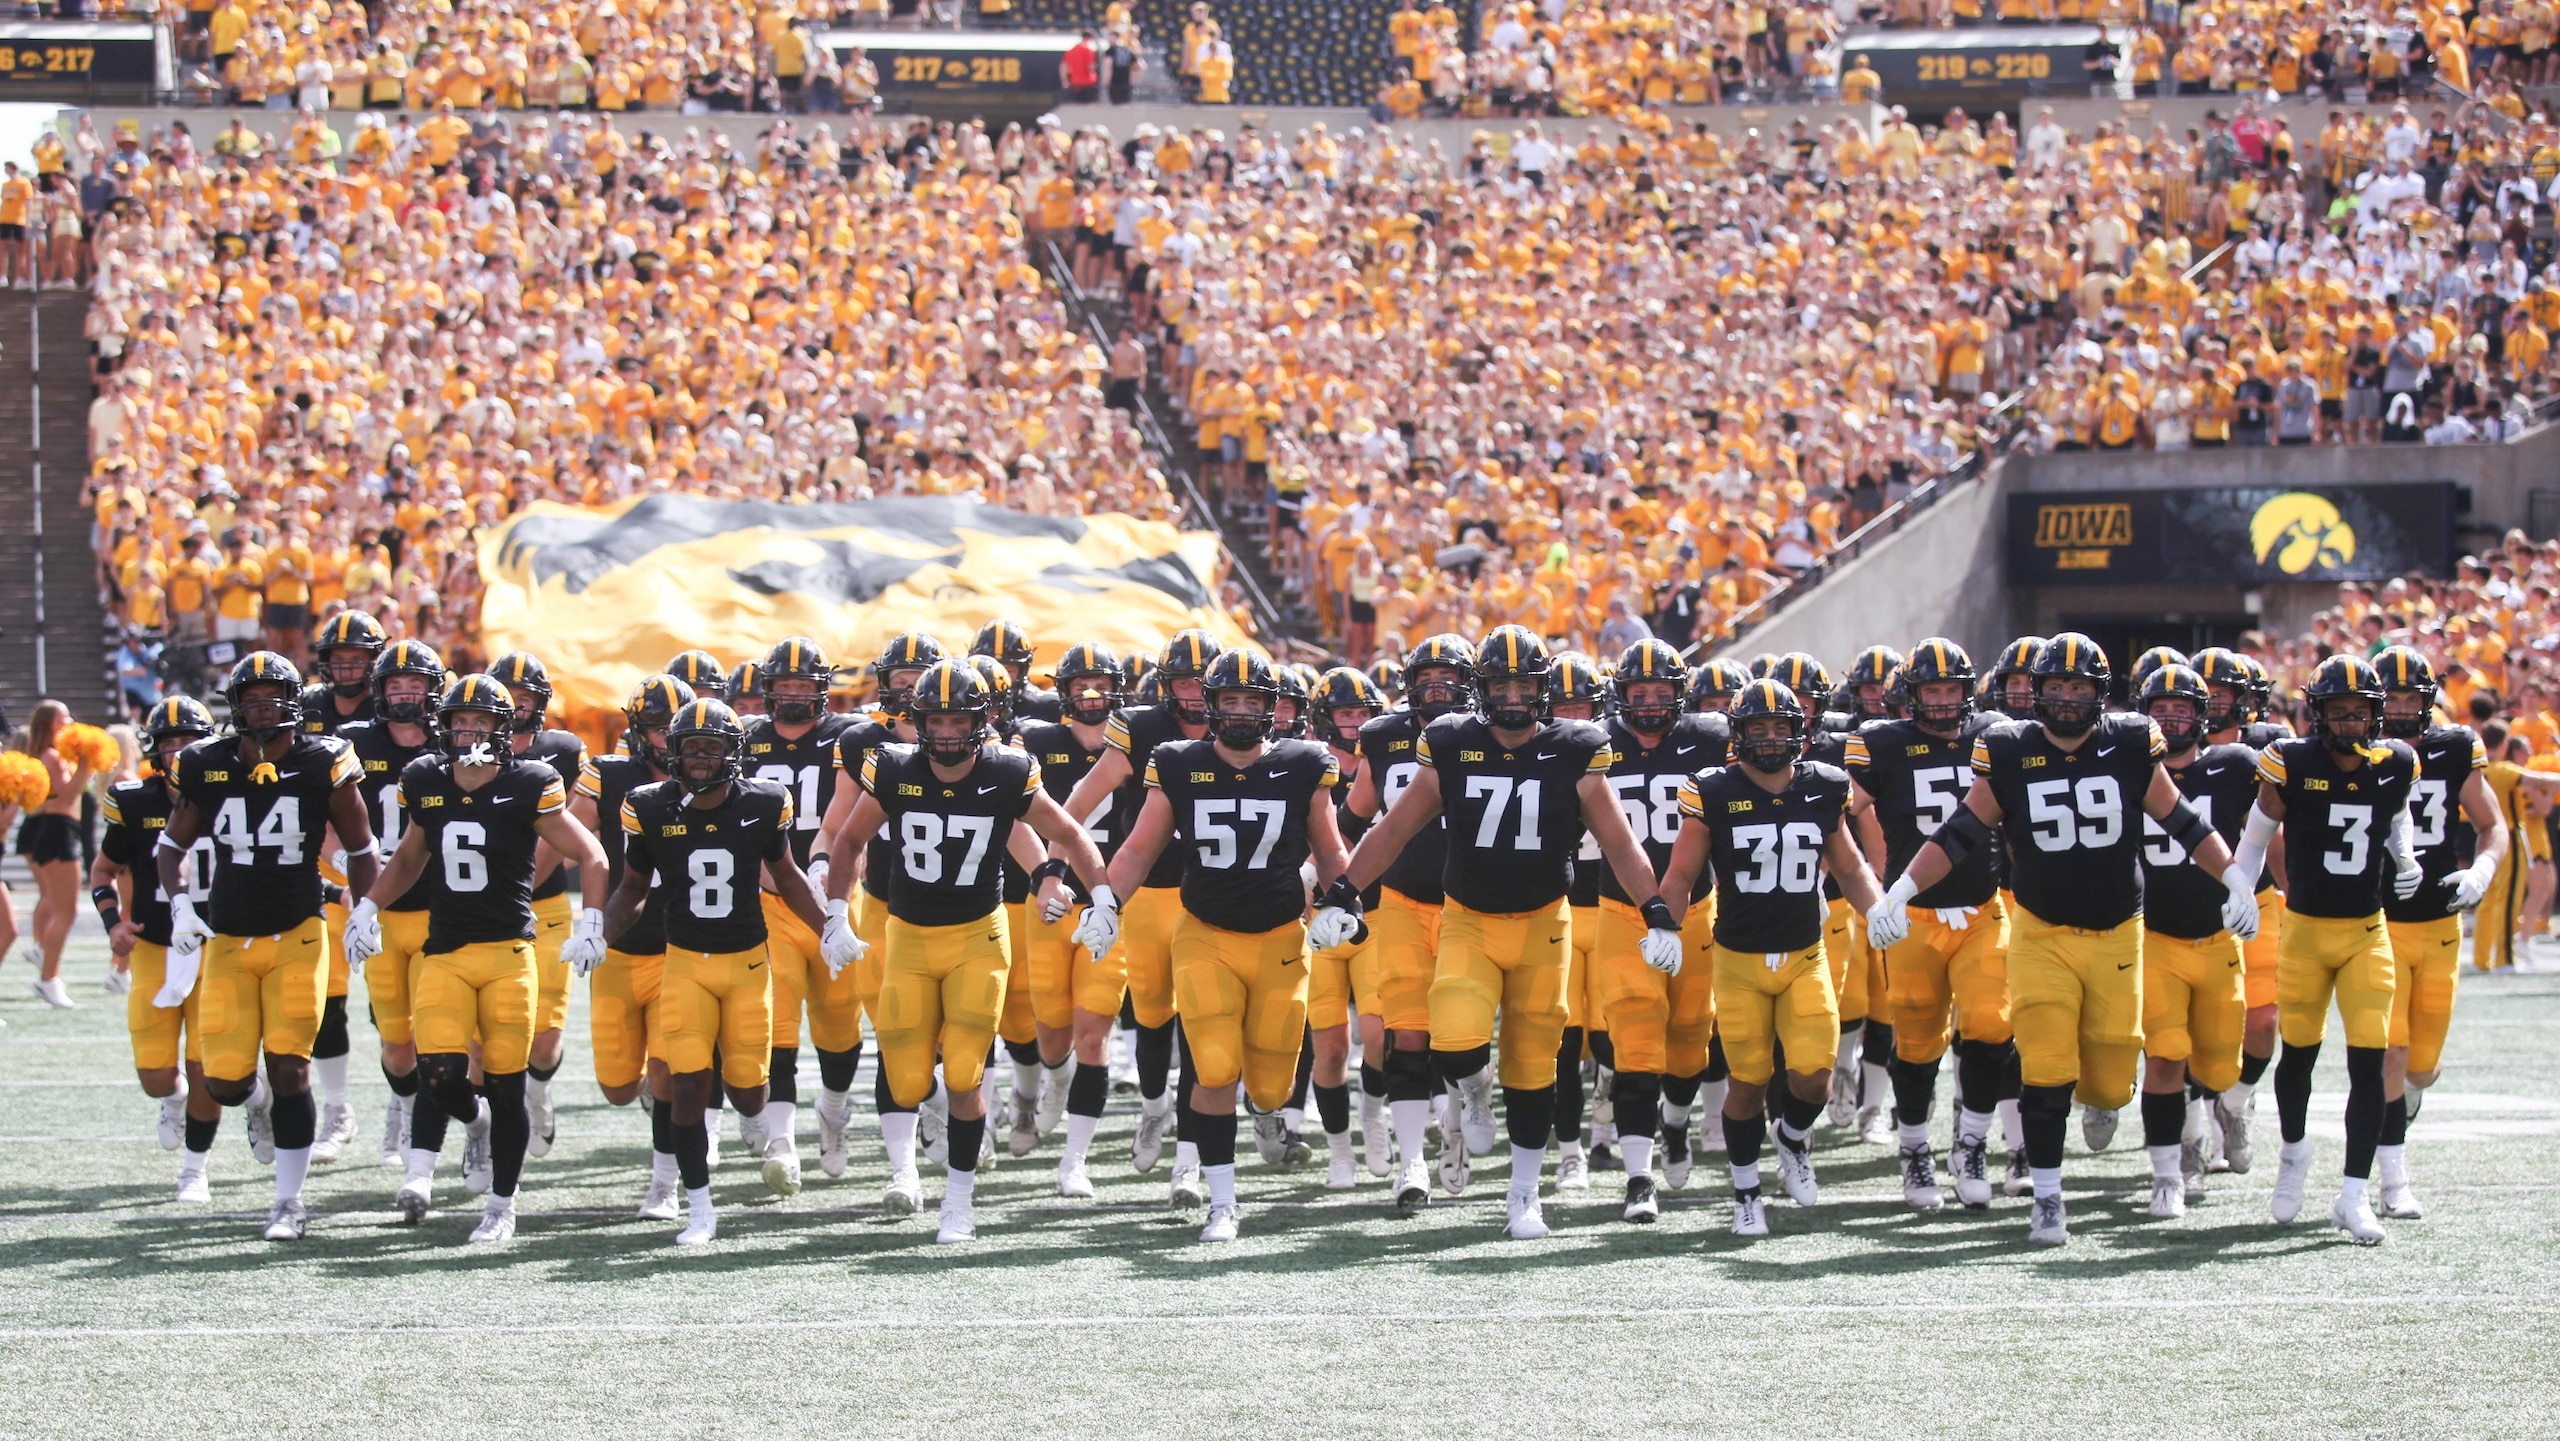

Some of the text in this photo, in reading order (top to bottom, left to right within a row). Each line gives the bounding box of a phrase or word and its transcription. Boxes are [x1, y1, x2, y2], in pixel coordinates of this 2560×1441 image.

[45, 46, 95, 72] 217
[893, 57, 1021, 82] 217 218
[1917, 54, 2050, 80] 219 220
[2035, 503, 2133, 547] IOWA
[213, 796, 307, 866] 44
[901, 811, 994, 886] 87
[1194, 798, 1287, 870] 57
[1465, 775, 1541, 850] 71
[2027, 775, 2123, 852] 59
[2323, 803, 2373, 875] 3
[442, 820, 489, 892] 6
[688, 848, 734, 919] 8
[1731, 822, 1823, 894] 36
